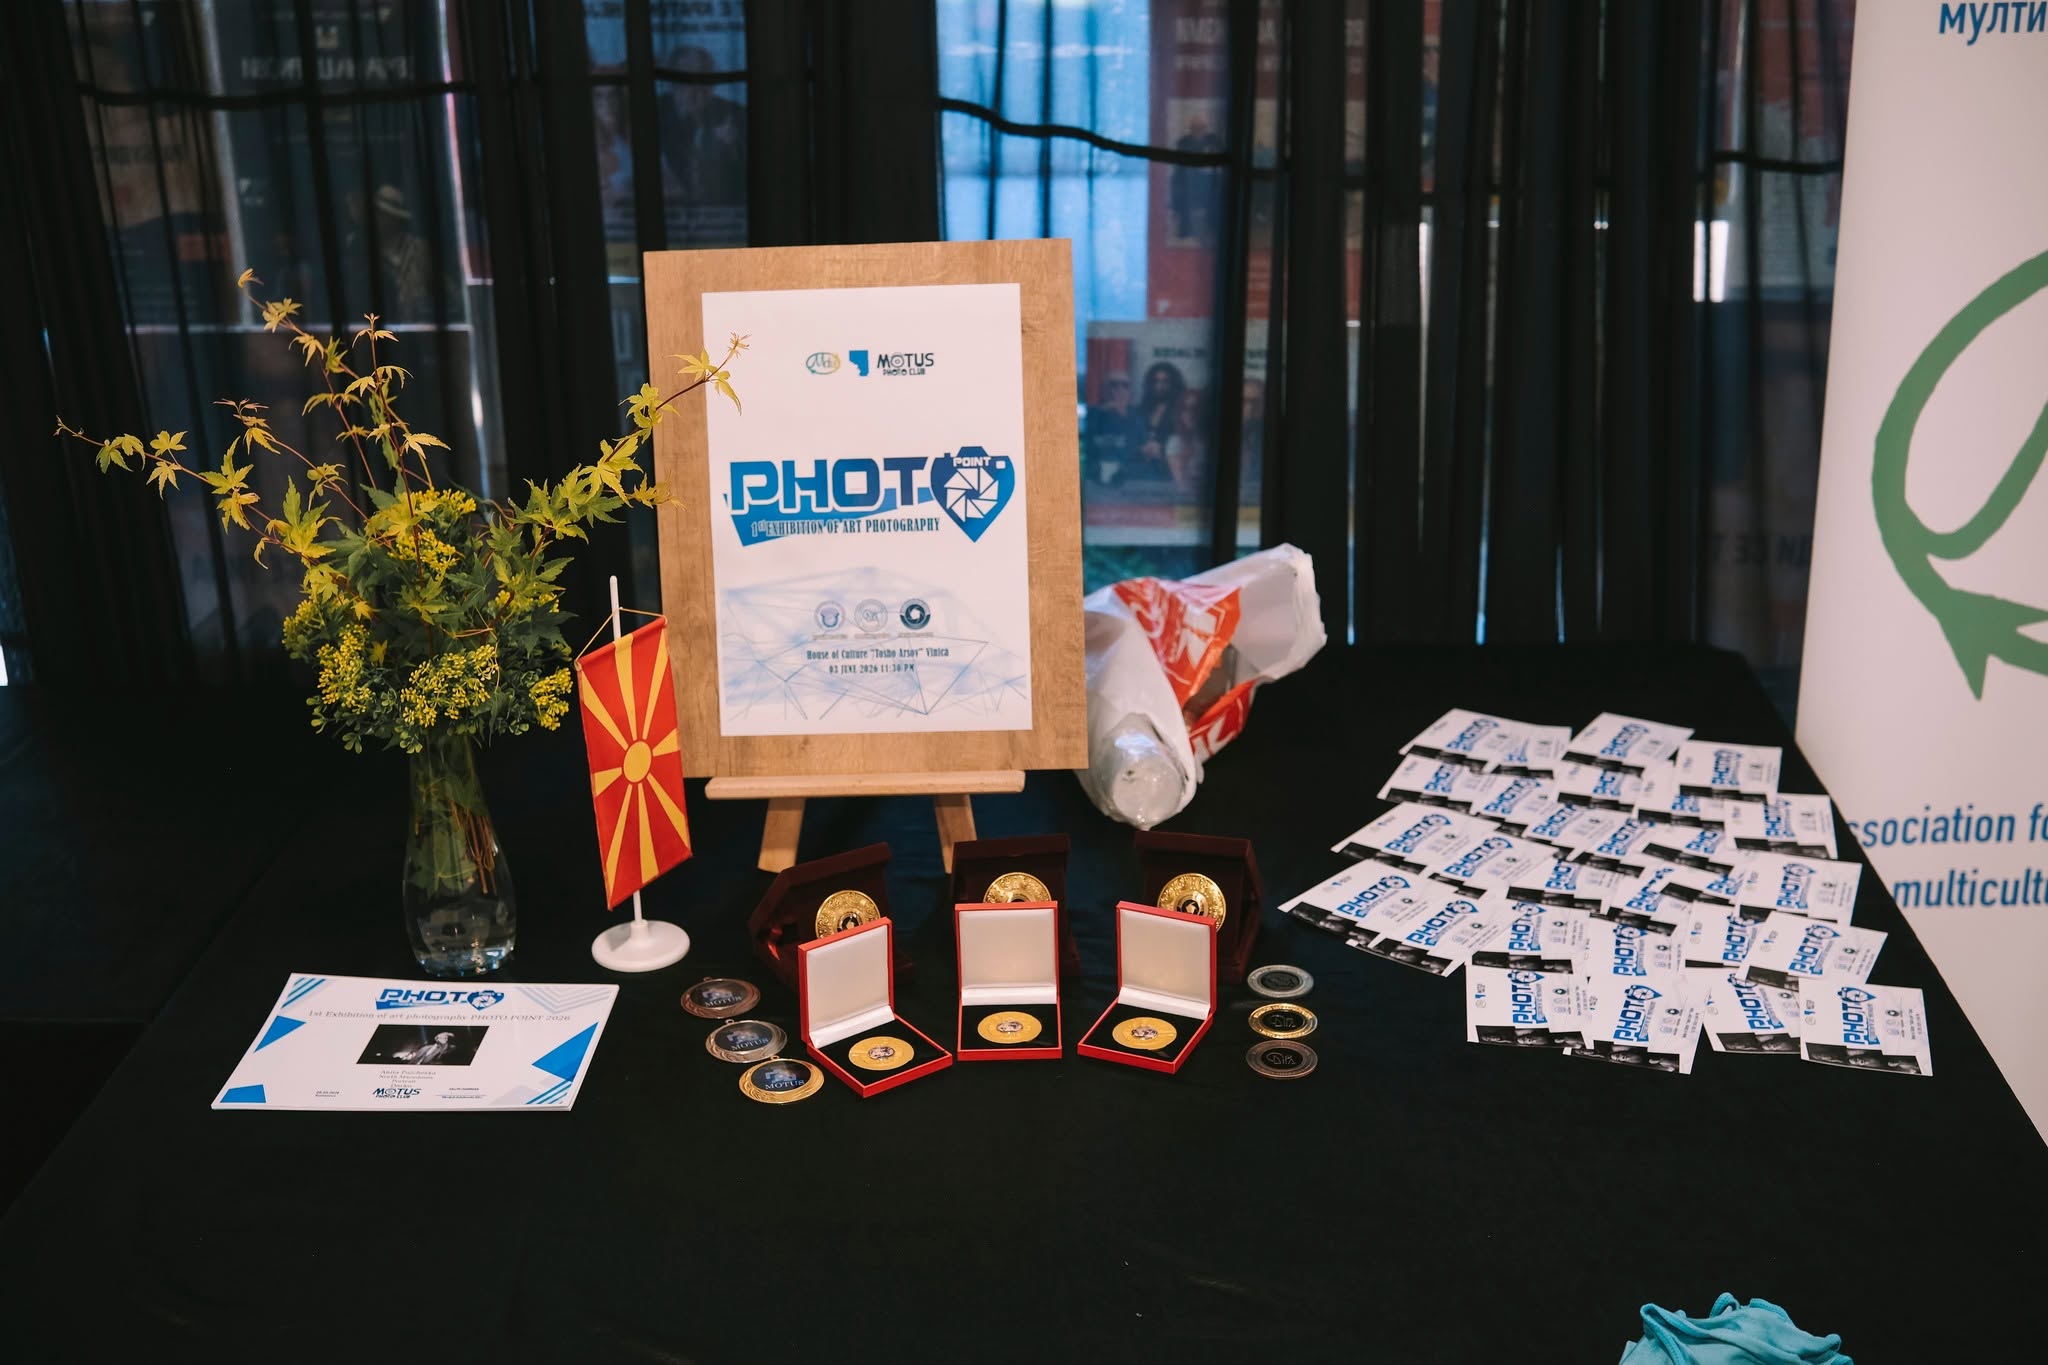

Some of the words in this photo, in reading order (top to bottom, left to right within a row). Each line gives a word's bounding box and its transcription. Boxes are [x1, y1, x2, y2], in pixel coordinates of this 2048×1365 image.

[877, 352, 934, 368] MOTUS
[953, 456, 991, 467] POINT
[766, 519, 824, 536] EXHIBITION
[826, 519, 841, 535] OF
[843, 518, 862, 533] ART
[866, 517, 940, 533] PHOTOGRAPHY
[806, 650, 829, 660] House
[831, 649, 839, 659] of
[841, 649, 868, 659] Culture
[841, 664, 856, 674] JUNE
[904, 663, 915, 671] PM
[1846, 804, 2016, 848] sociation
[765, 1080, 804, 1090] MOTUS
[373, 1087, 422, 1096] MOTUS
